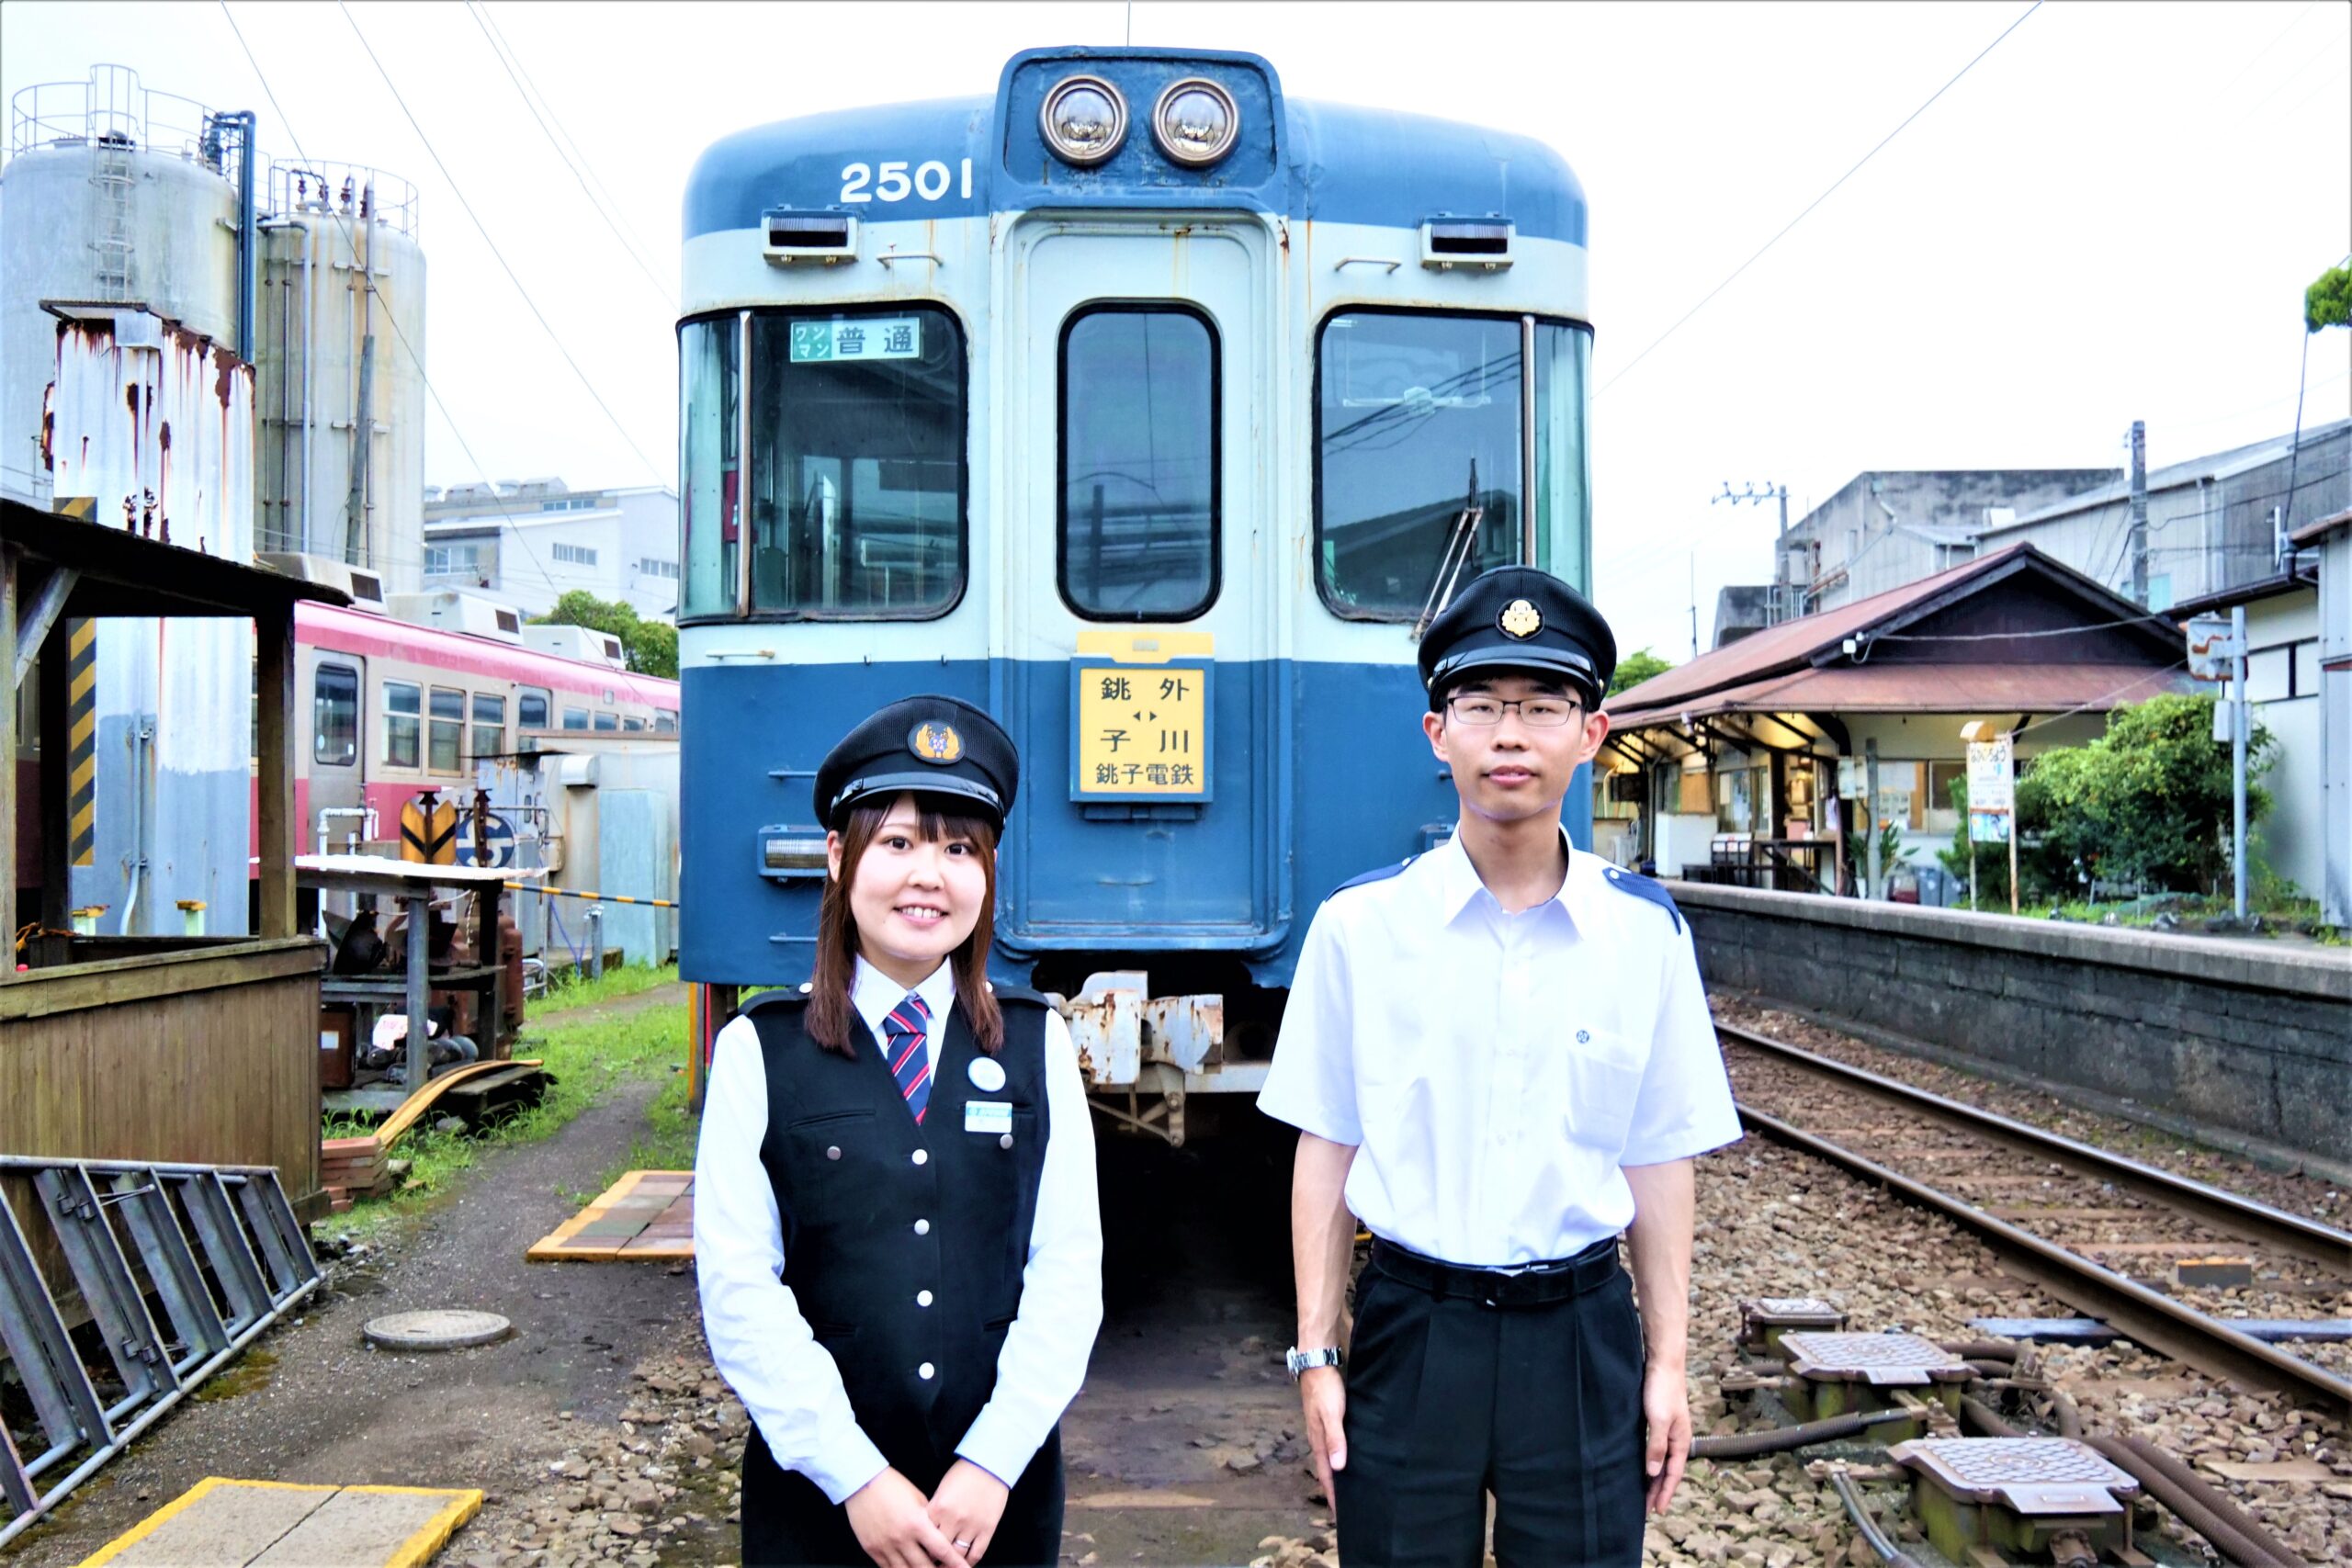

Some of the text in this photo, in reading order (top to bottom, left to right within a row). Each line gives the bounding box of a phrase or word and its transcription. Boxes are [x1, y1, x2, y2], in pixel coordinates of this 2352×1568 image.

[840, 158, 972, 203] 2501
[796, 326, 825, 341] ワン
[836, 325, 913, 355] 普通
[798, 344, 829, 357] マン
[1100, 677, 1132, 753] 銚子
[1159, 678, 1191, 753] 外川
[1095, 763, 1194, 785] 銚子電鉄
